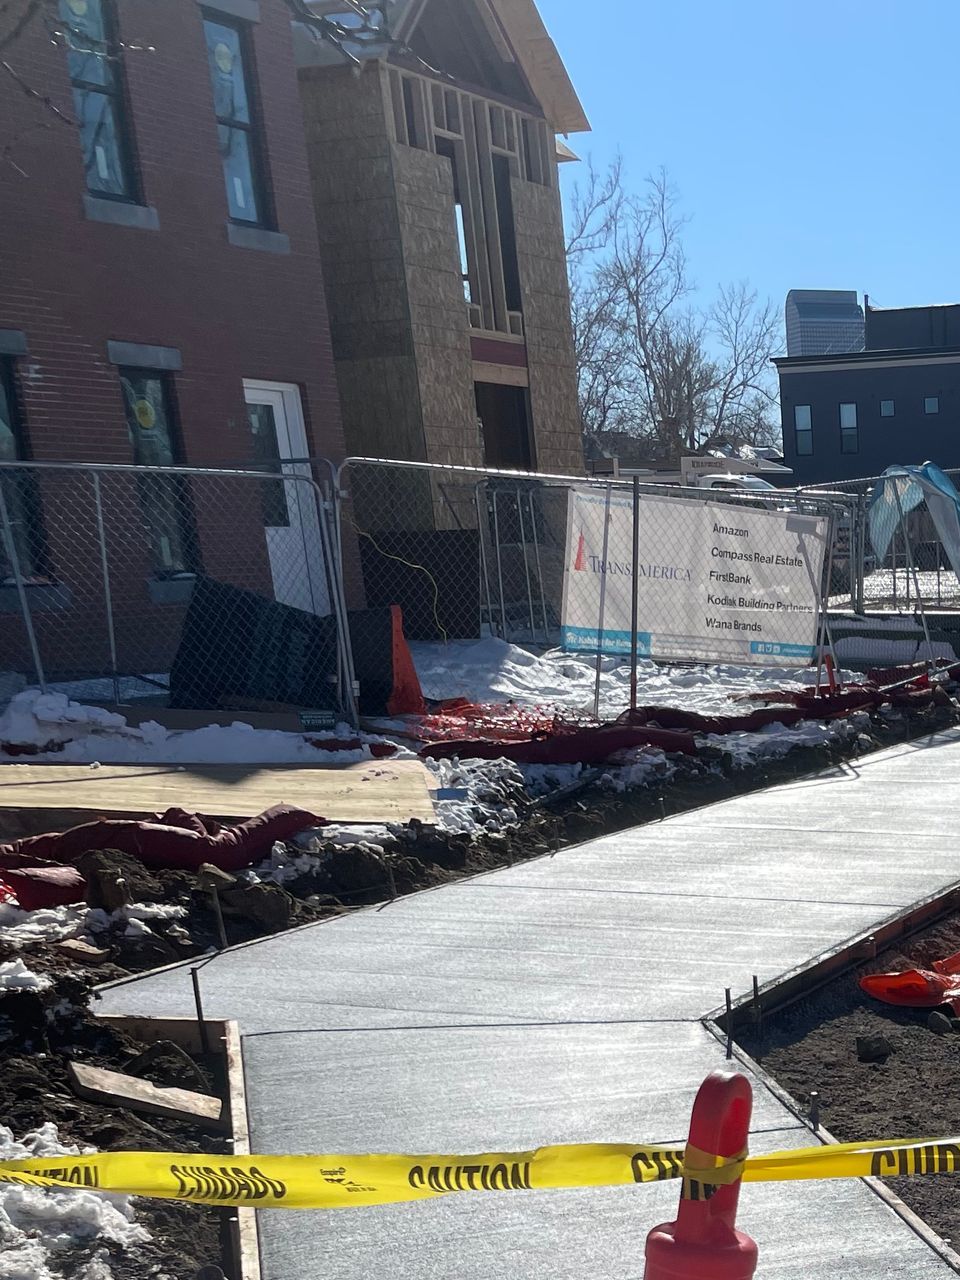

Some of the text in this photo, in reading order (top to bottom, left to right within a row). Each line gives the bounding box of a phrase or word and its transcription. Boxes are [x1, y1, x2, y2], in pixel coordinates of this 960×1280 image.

[713, 523, 749, 537] Amazon
[712, 547, 803, 567] Compass Real Estate
[709, 570, 751, 584] FirstBank
[707, 594, 813, 613] Kodiak Building Partners
[706, 617, 762, 632] Wana Brands
[170, 1164, 287, 1199] CUIDADO
[408, 1162, 533, 1192] CAUTION
